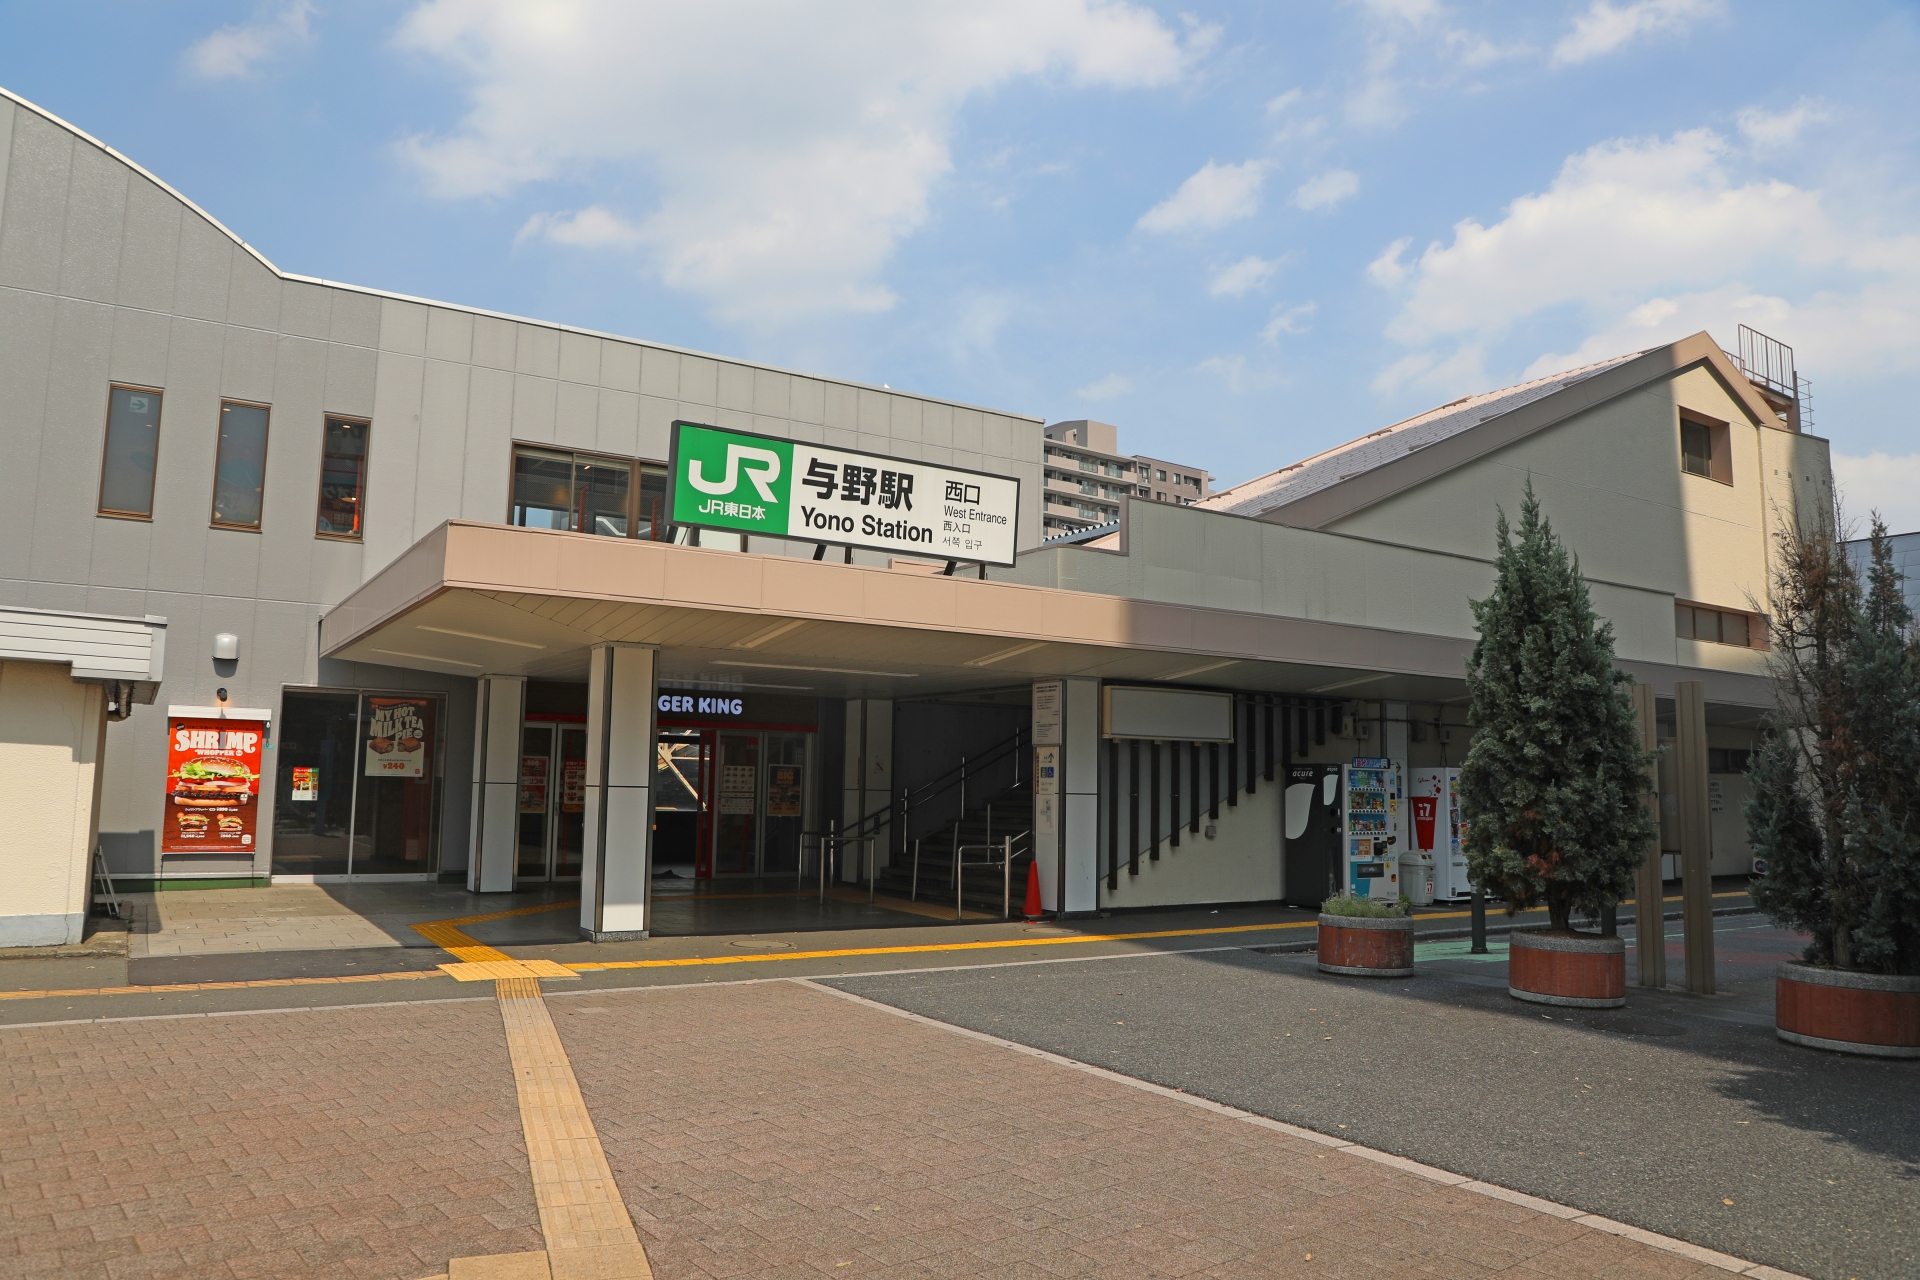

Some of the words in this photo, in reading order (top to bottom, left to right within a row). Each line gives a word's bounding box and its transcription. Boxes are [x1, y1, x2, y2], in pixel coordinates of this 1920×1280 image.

[688, 443, 781, 503] JR
[801, 457, 914, 512] 与野駅
[945, 479, 981, 505] 西口
[698, 498, 766, 521] JR東日本
[944, 505, 967, 520] West
[969, 508, 1007, 526] Entrance
[801, 505, 854, 533] Yono
[861, 512, 933, 544] Station
[942, 520, 971, 534] 西入口
[942, 535, 962, 548] 서쪽
[965, 538, 983, 551] 입구
[375, 708, 393, 722] MY
[393, 706, 415, 720] HOT
[698, 697, 743, 715] KING
[369, 717, 403, 738] MILK
[404, 715, 425, 732] TEA
[395, 728, 414, 742] PIE
[174, 729, 258, 754] SHRIMP
[194, 749, 235, 757] WHOPPER
[382, 762, 405, 770] ¥240
[776, 771, 794, 780] BIG
